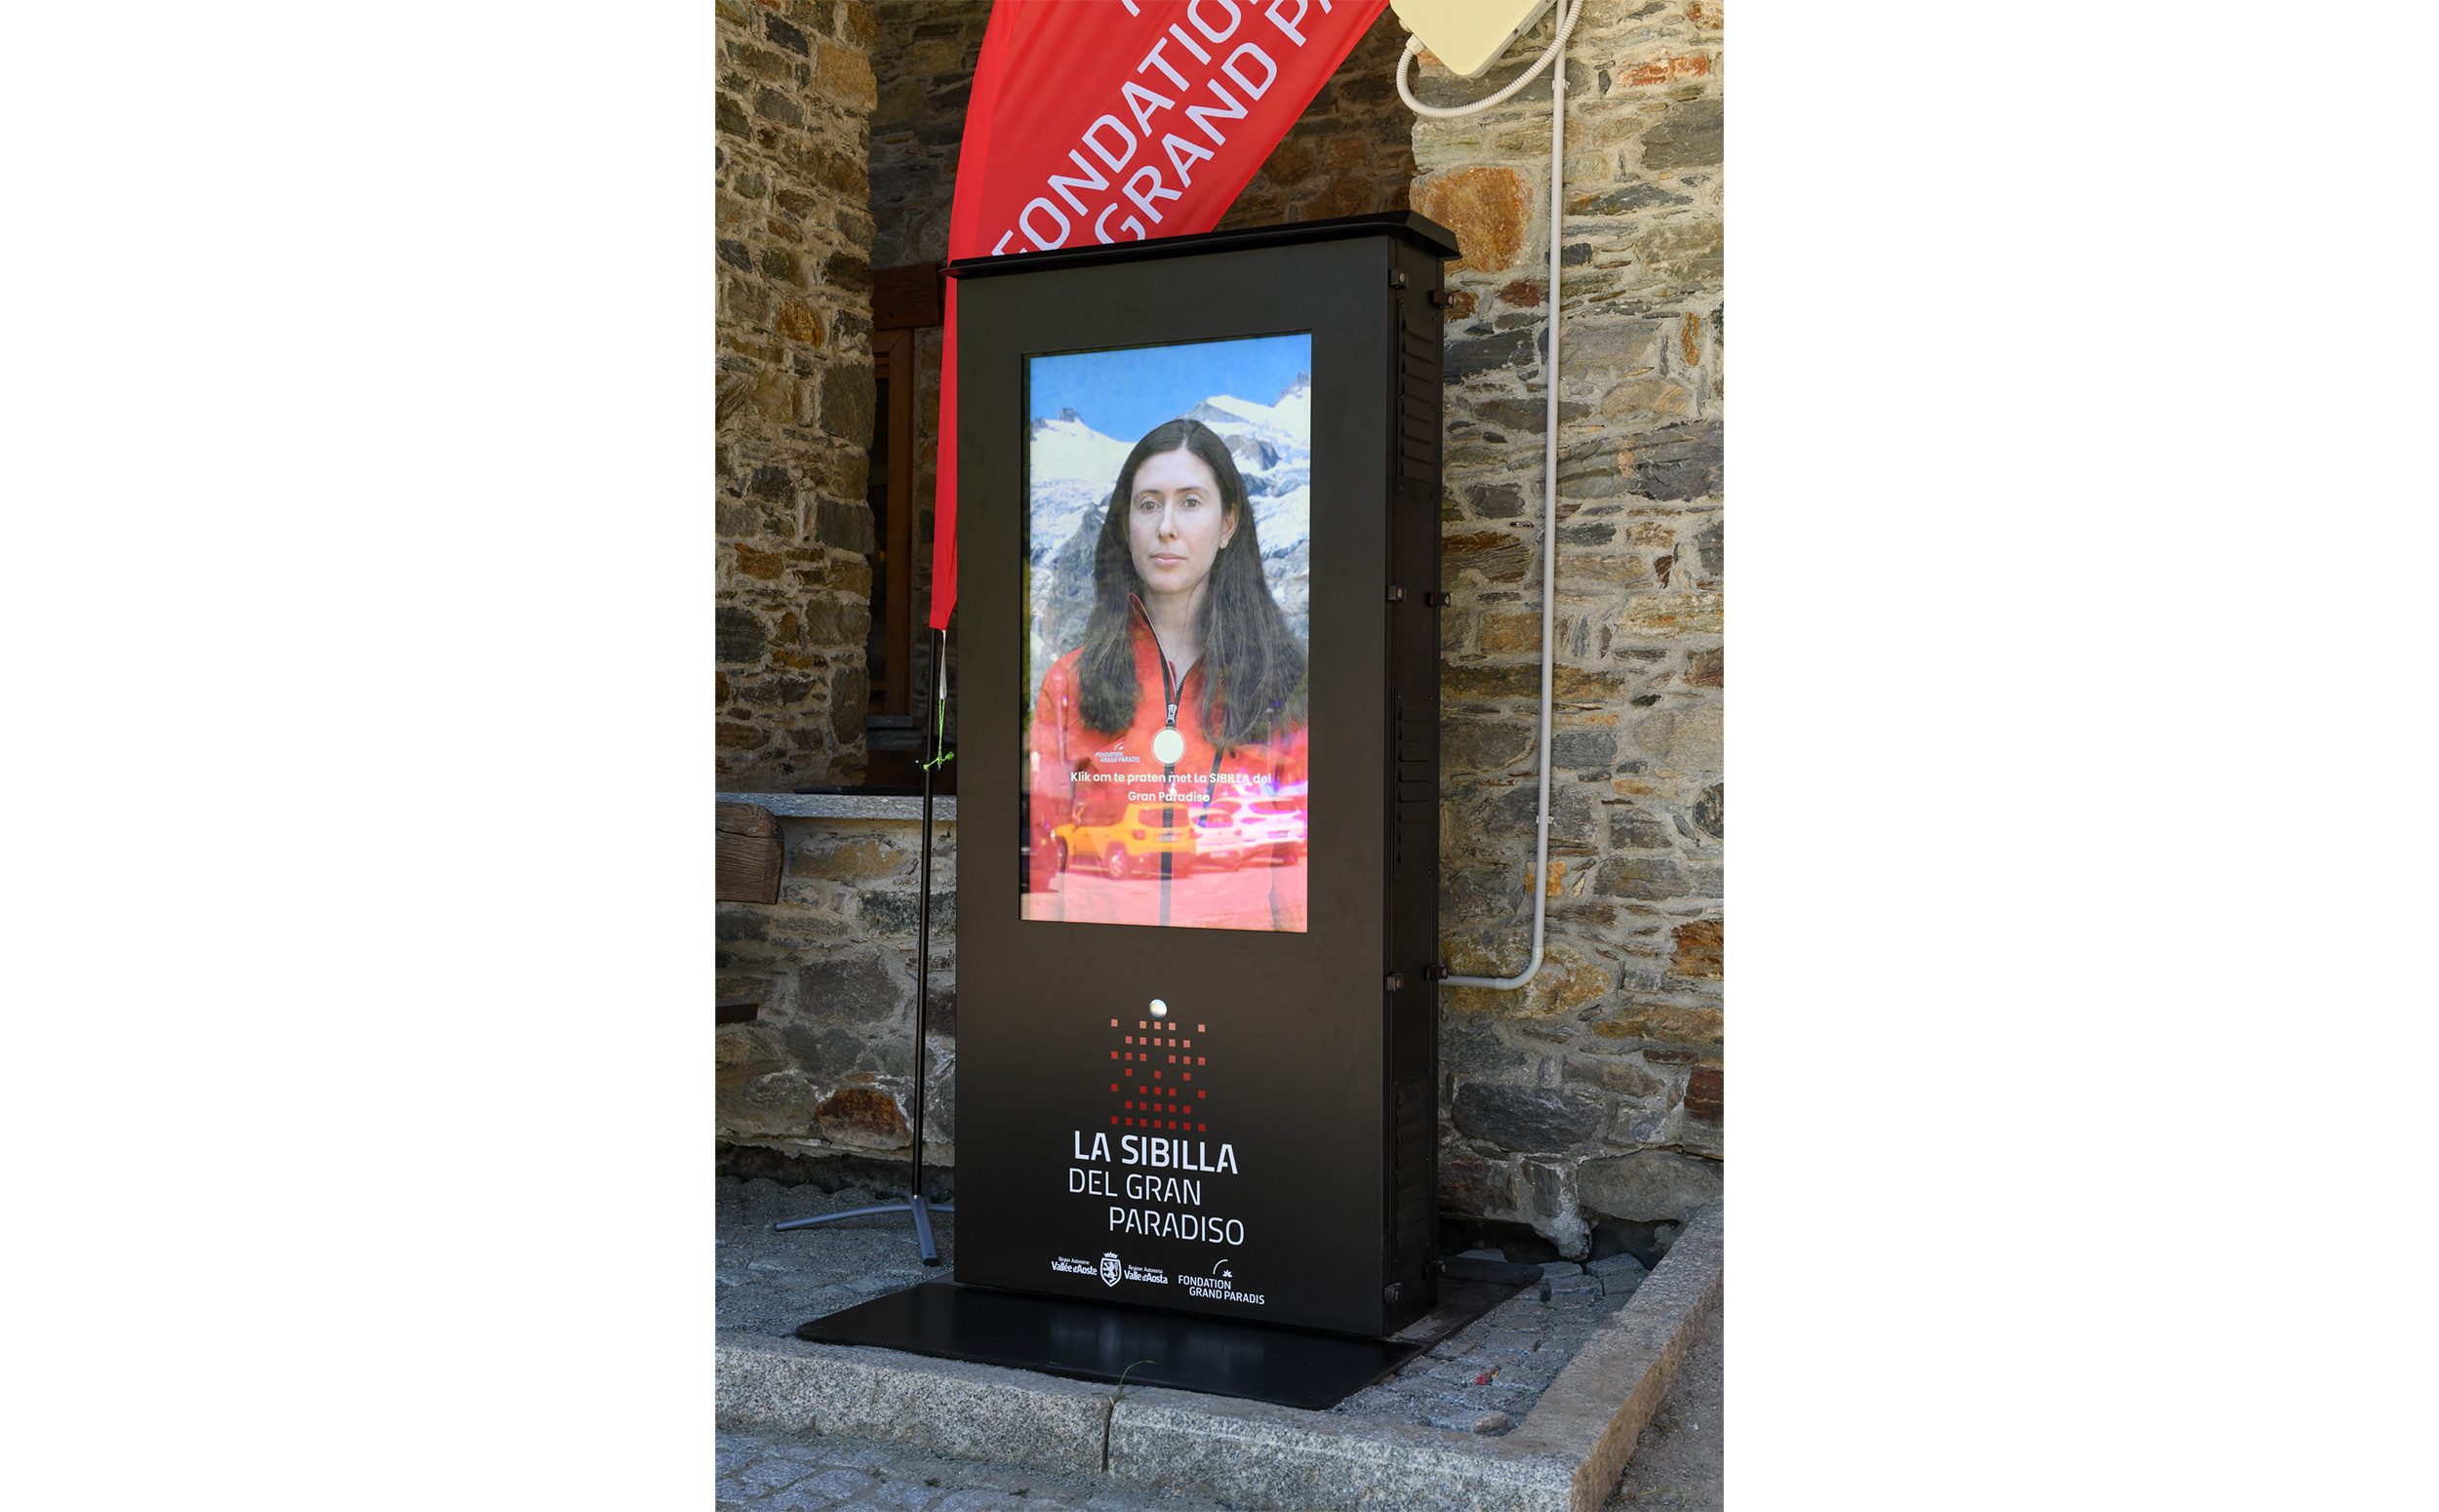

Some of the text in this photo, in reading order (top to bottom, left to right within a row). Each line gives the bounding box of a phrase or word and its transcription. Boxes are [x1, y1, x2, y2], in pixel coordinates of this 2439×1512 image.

[991, 0, 1259, 257] ONDATIO
[1095, 0, 1333, 245] GRAND P
[1119, 755, 1140, 764] PARADIS
[1070, 771, 1272, 786] Klik om te praten met La SIBILLA del
[1128, 791, 1211, 803] Gran Paradiso
[1074, 1130, 1239, 1175] LA SIBILLA
[1068, 1168, 1201, 1206] DEL GRAN
[1109, 1206, 1245, 1246] PARADISO
[1051, 1260, 1099, 1276] Vallée d'Aoste
[1123, 1269, 1169, 1285] Valle d'Aosta
[1178, 1274, 1232, 1291] FONDATION
[1189, 1286, 1265, 1305] GRAND PARADIS
